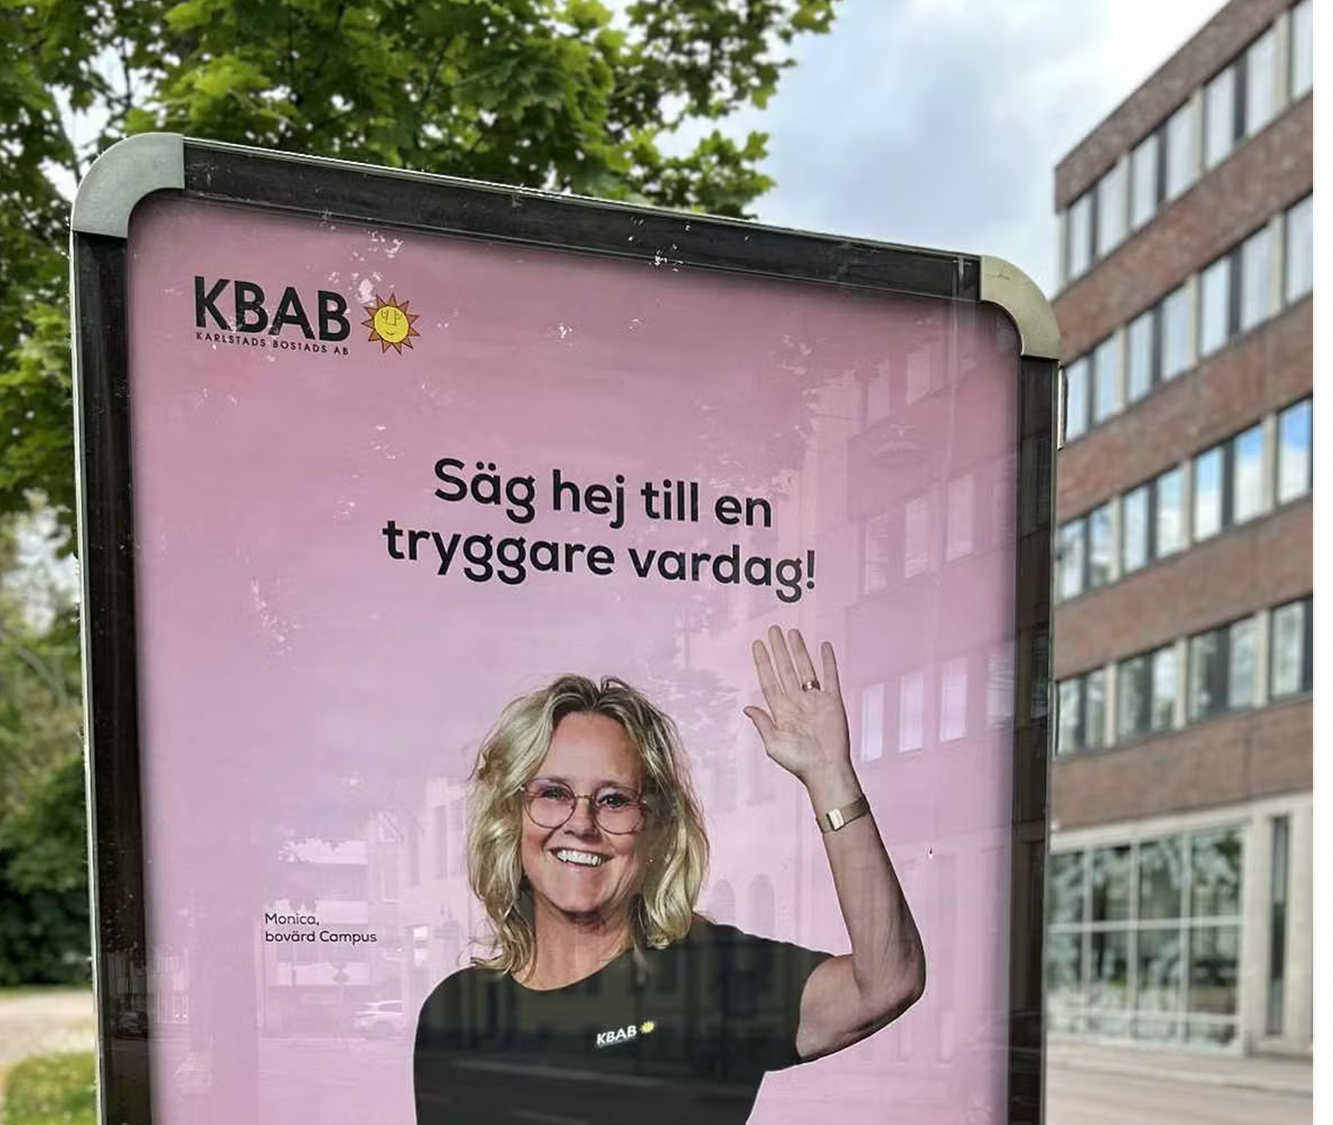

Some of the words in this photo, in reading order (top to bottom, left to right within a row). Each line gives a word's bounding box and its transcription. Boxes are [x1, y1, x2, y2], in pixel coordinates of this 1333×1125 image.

[194, 275, 350, 342] KBAB
[196, 332, 266, 348] KARLSTADS
[272, 340, 327, 354] BOSTADS
[333, 345, 349, 356] AB
[433, 457, 536, 524] Säg
[552, 469, 625, 529] hej
[640, 479, 699, 522] till
[714, 495, 772, 528] en
[382, 520, 615, 585] tryggare
[628, 545, 816, 603] vardag!
[264, 912, 320, 926] Monica,
[265, 930, 316, 943] bovärd
[319, 930, 378, 945] Campus
[596, 1025, 637, 1045] KBAB
